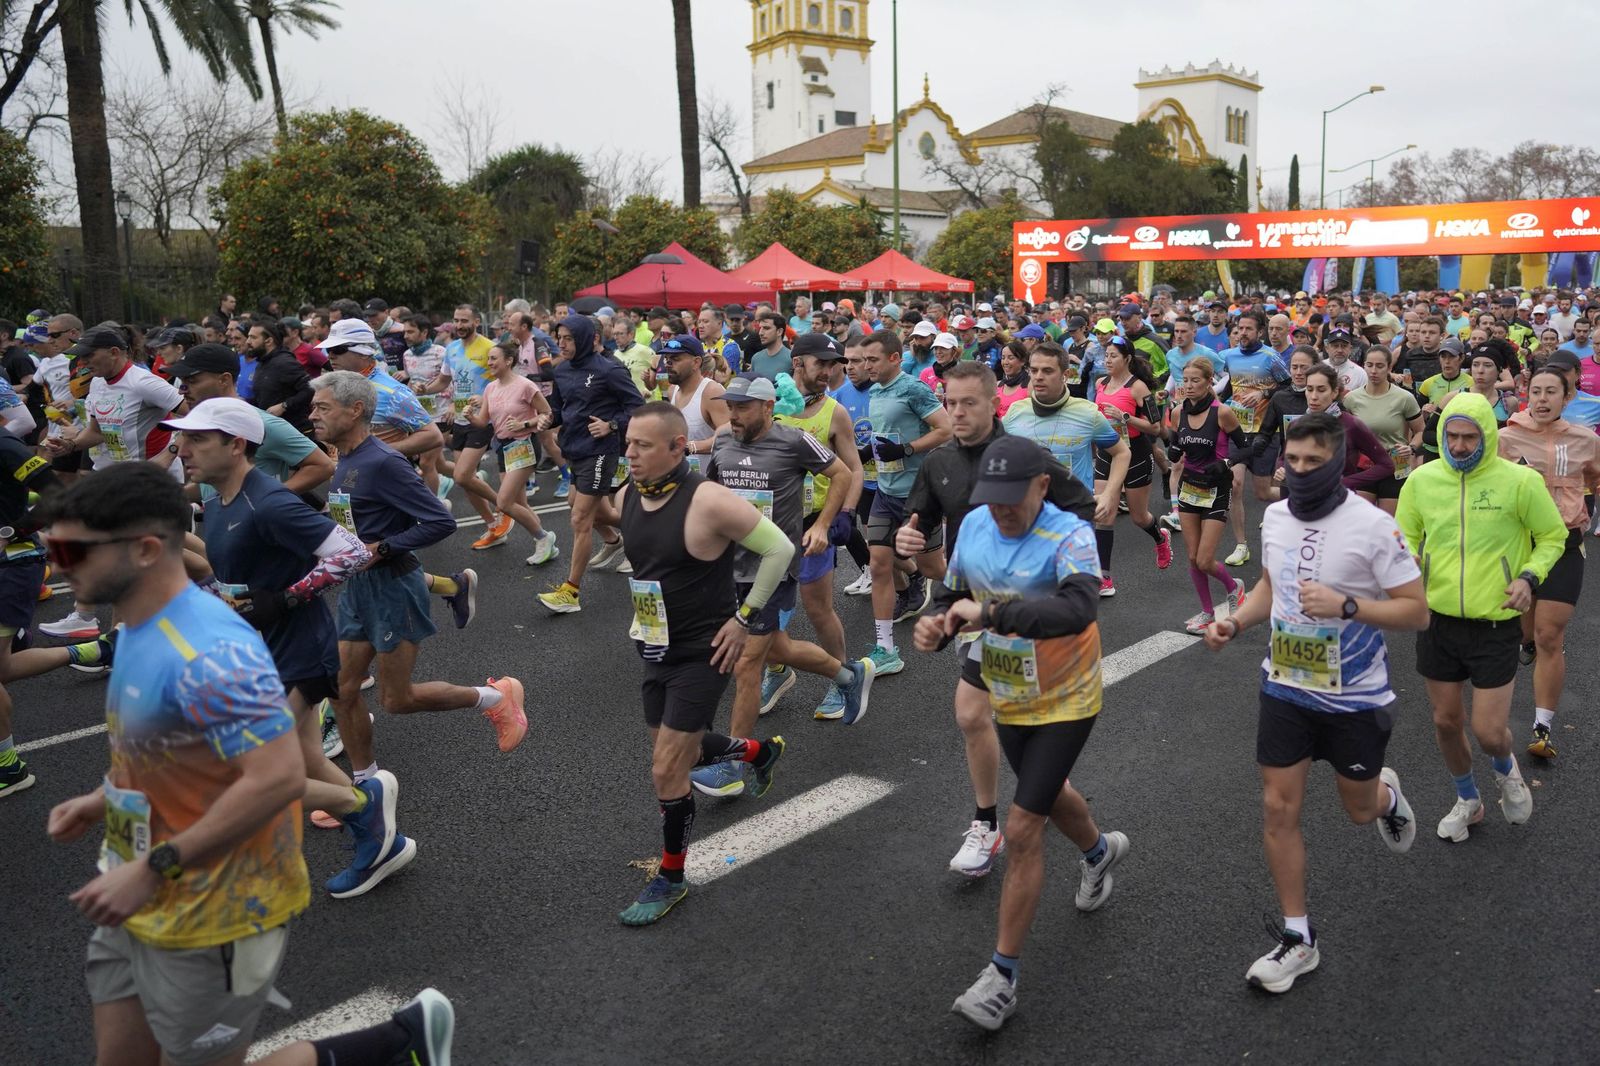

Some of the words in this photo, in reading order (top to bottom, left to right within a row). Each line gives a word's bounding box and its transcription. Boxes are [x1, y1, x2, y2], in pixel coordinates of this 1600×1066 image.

[1434, 218, 1491, 237] HOKA
[1167, 229, 1211, 246] HOKA
[722, 470, 739, 478] BMW
[740, 470, 769, 480] BERLIN
[723, 478, 769, 489] MARATHON
[1275, 635, 1327, 663] 11452
